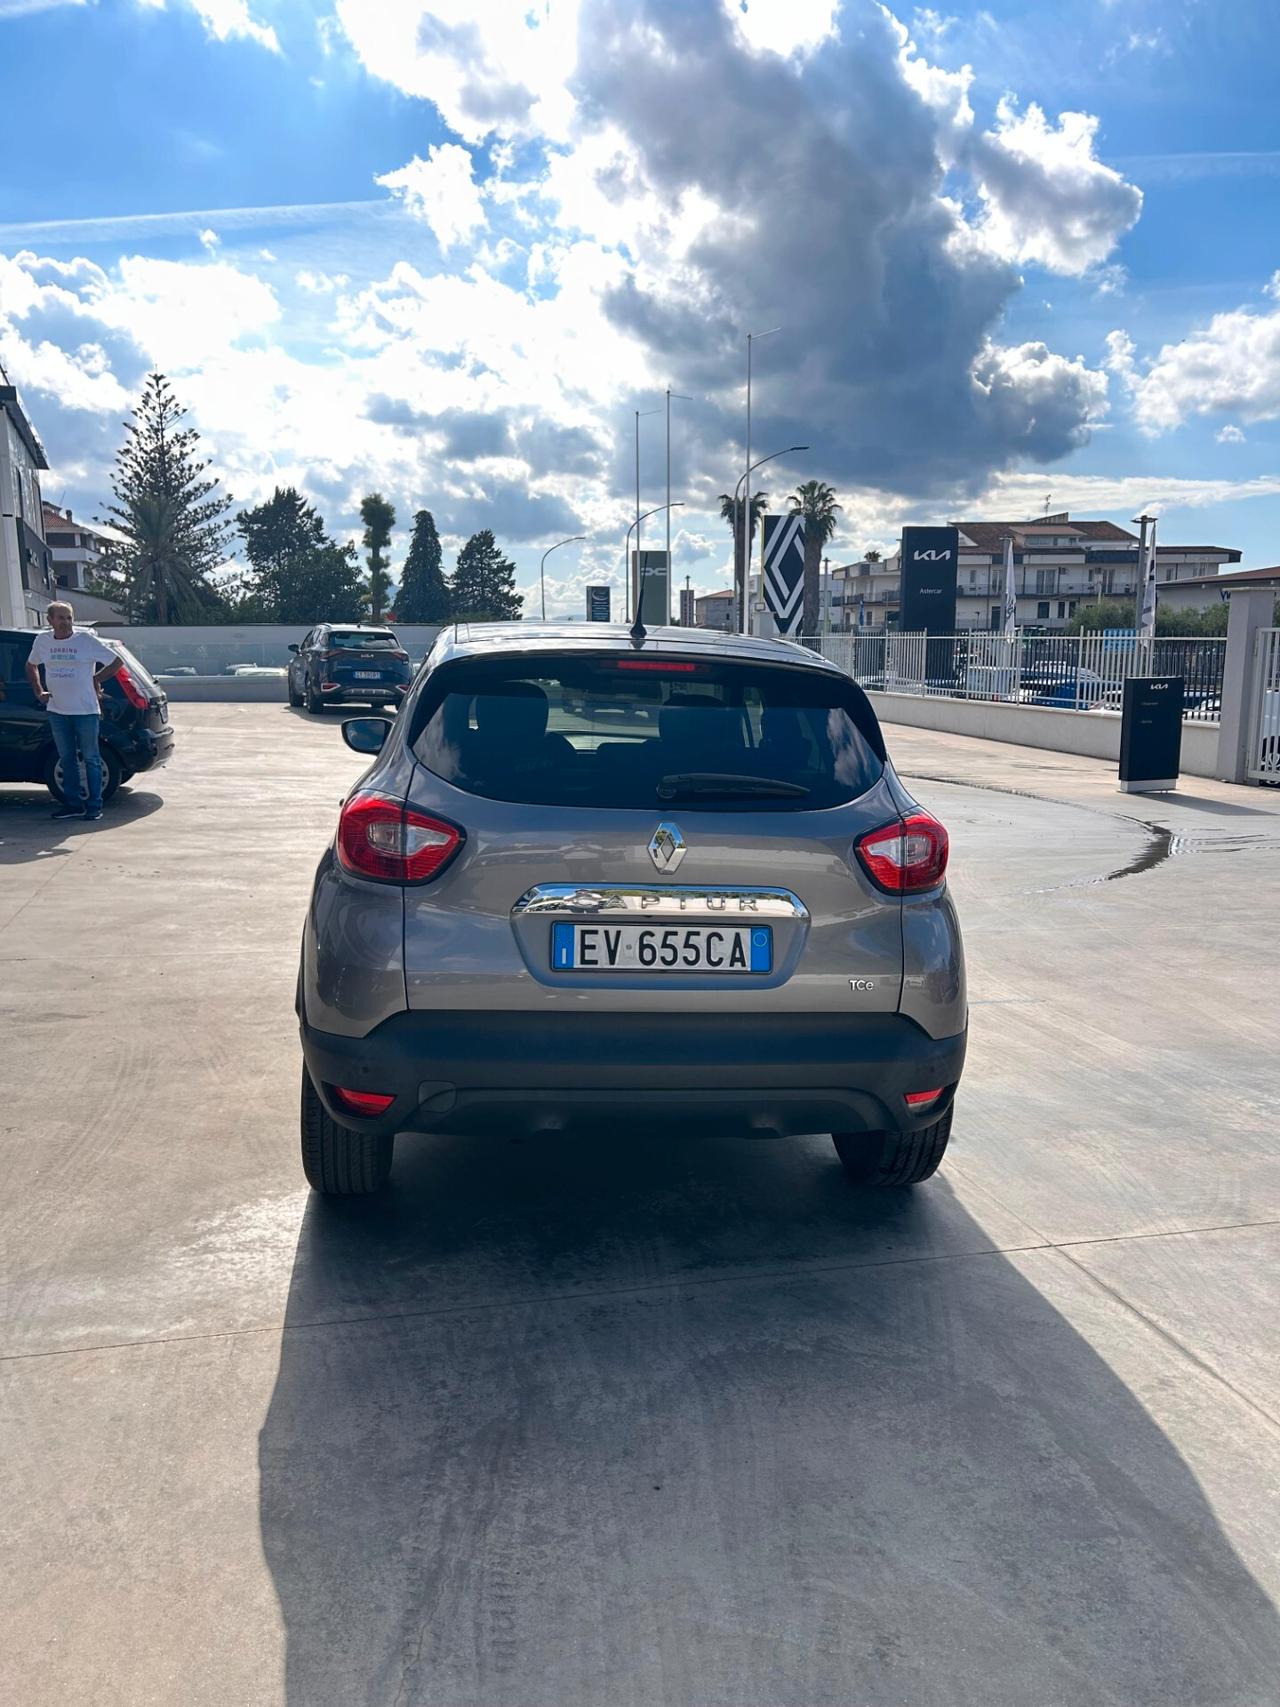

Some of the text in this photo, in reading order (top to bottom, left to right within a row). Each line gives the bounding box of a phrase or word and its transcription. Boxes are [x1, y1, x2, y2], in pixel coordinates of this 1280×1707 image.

[914, 550, 951, 561] KIA
[579, 929, 748, 969] EV 655CA
[850, 979, 874, 991] TCe
